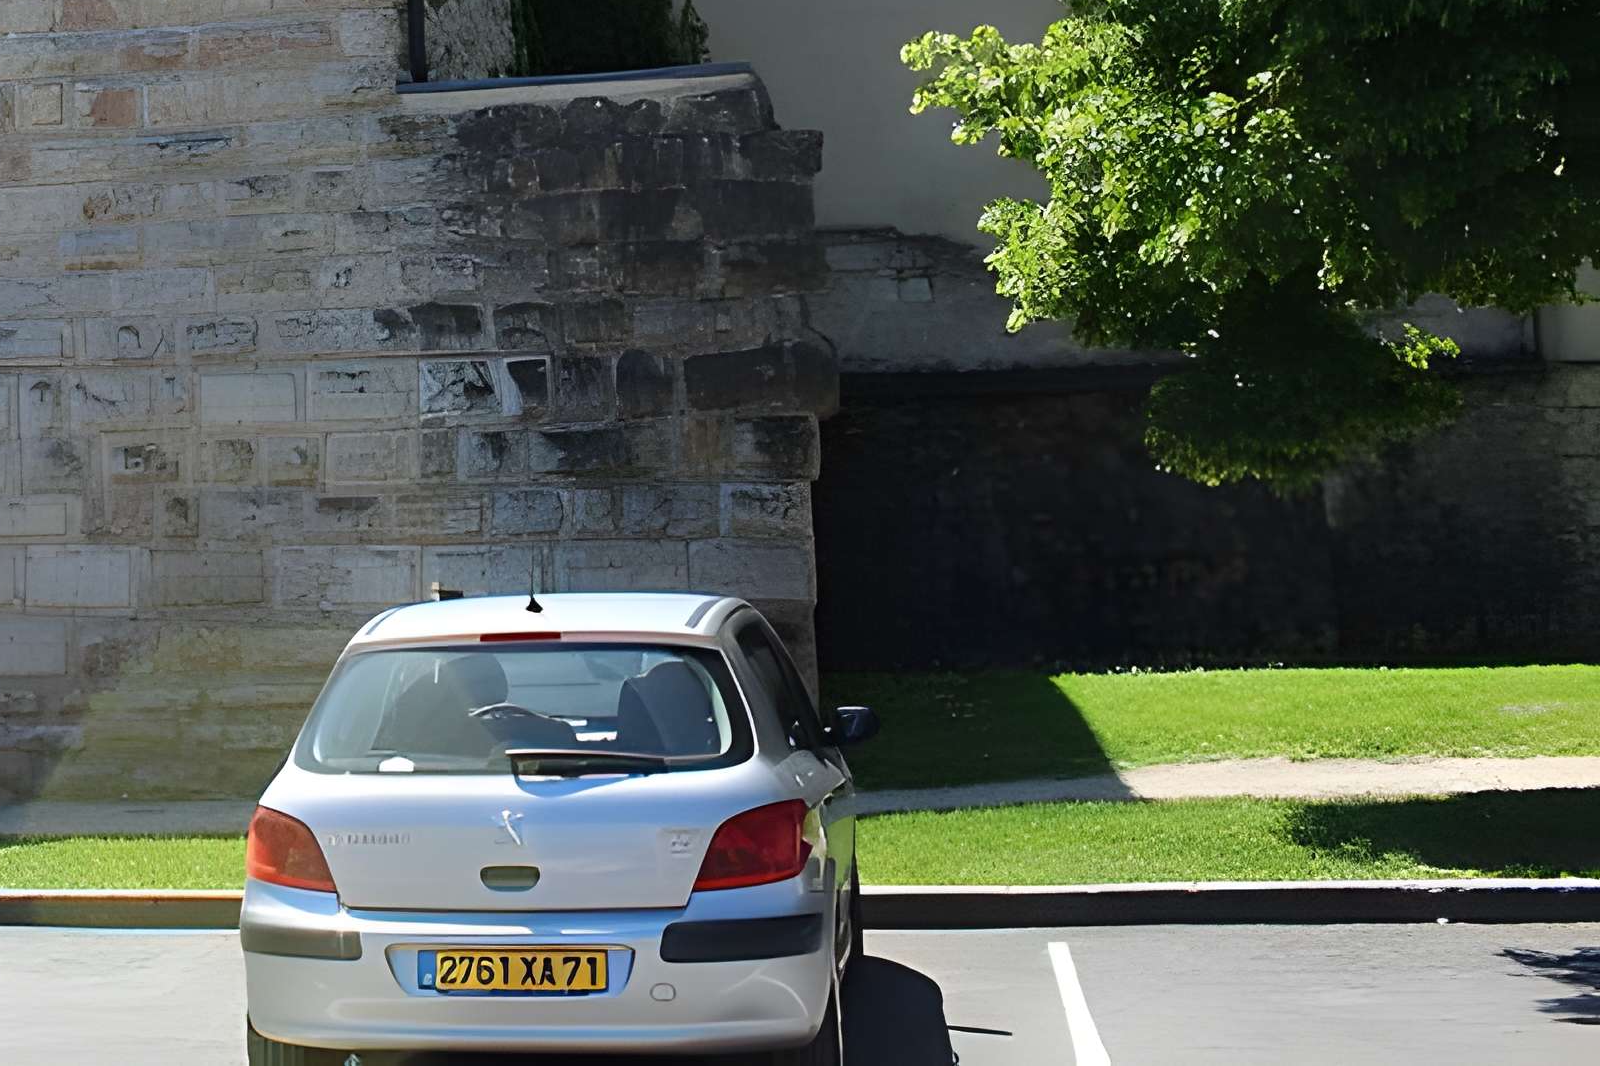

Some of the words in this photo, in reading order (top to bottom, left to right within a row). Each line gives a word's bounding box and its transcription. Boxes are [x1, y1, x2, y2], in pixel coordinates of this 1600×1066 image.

[439, 955, 510, 986] 2761
[519, 956, 556, 986] XA
[562, 956, 598, 987] 71
